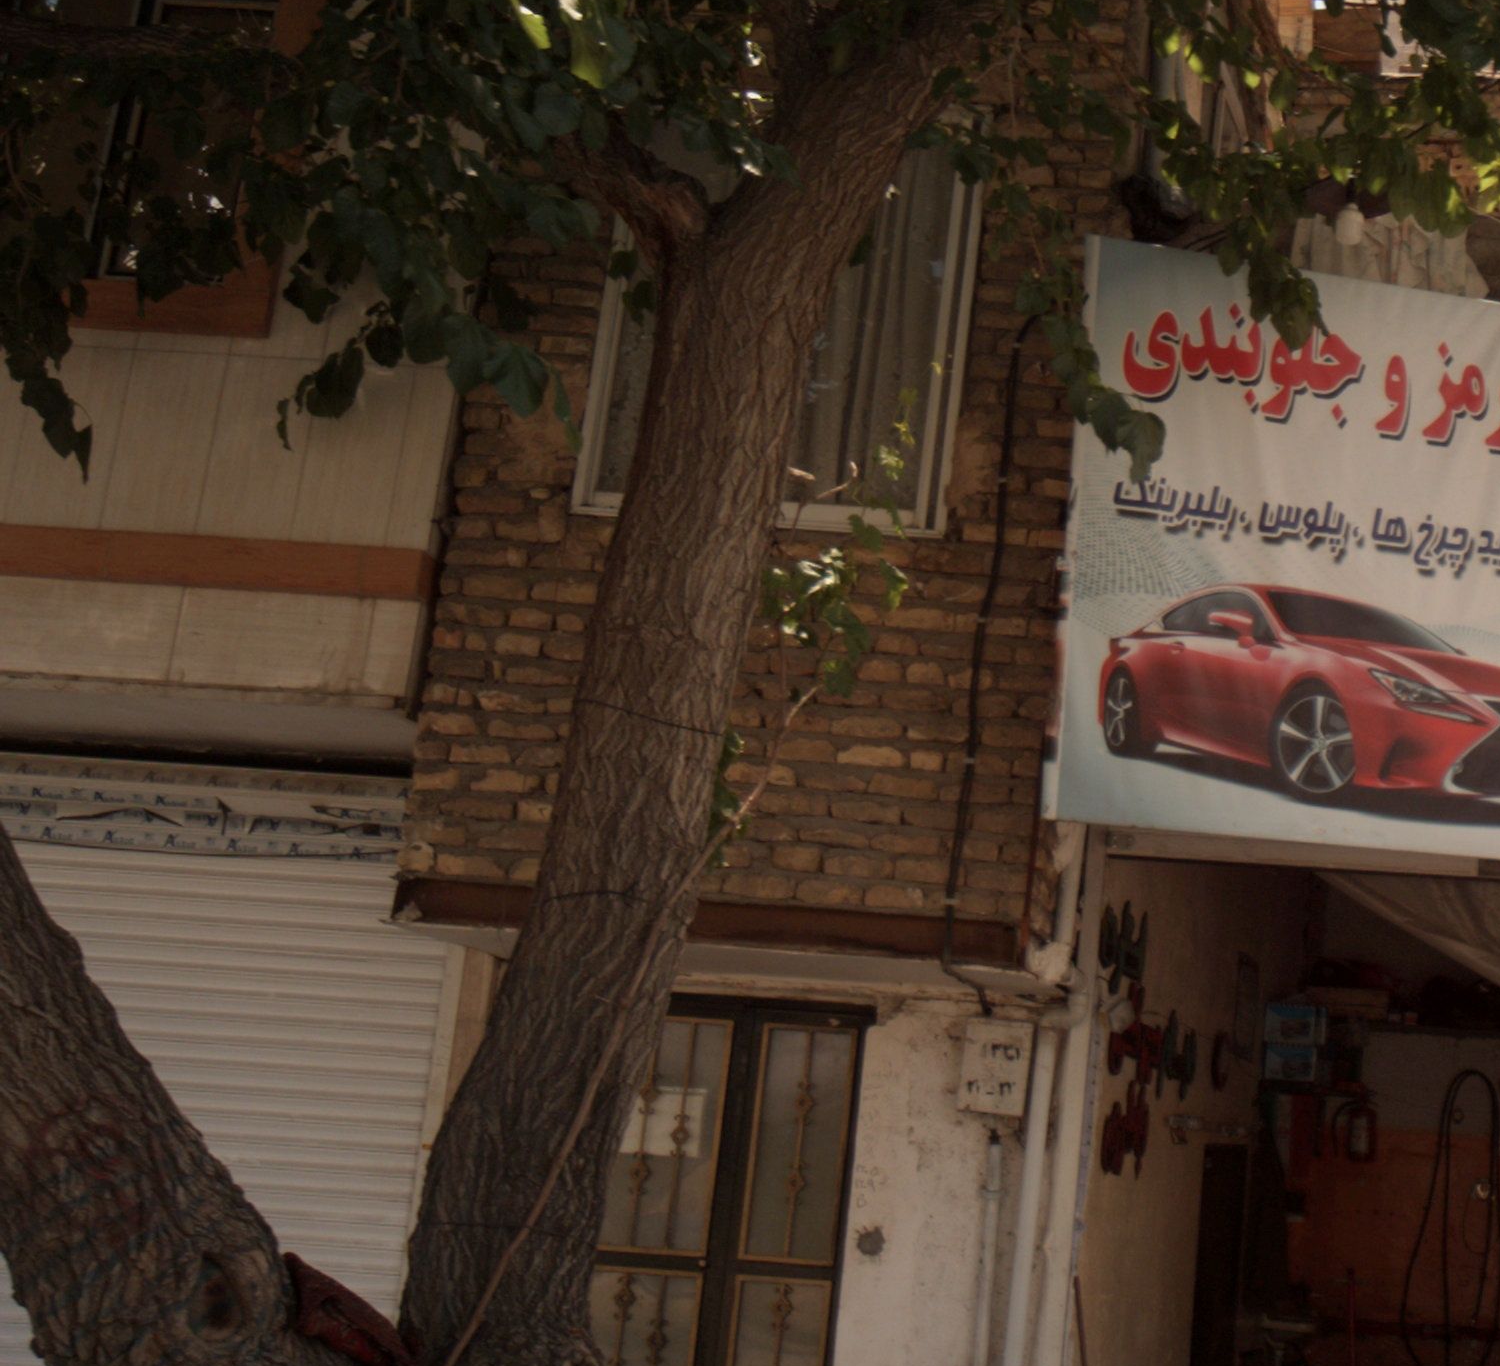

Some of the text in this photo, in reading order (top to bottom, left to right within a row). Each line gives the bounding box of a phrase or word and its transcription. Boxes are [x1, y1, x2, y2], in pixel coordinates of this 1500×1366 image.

[1121, 302, 1366, 428] جلوبندی
[1375, 354, 1413, 441] و
[1258, 500, 1350, 559] پلوس
[1371, 507, 1412, 552] ها
[1413, 514, 1472, 576] چرخ
